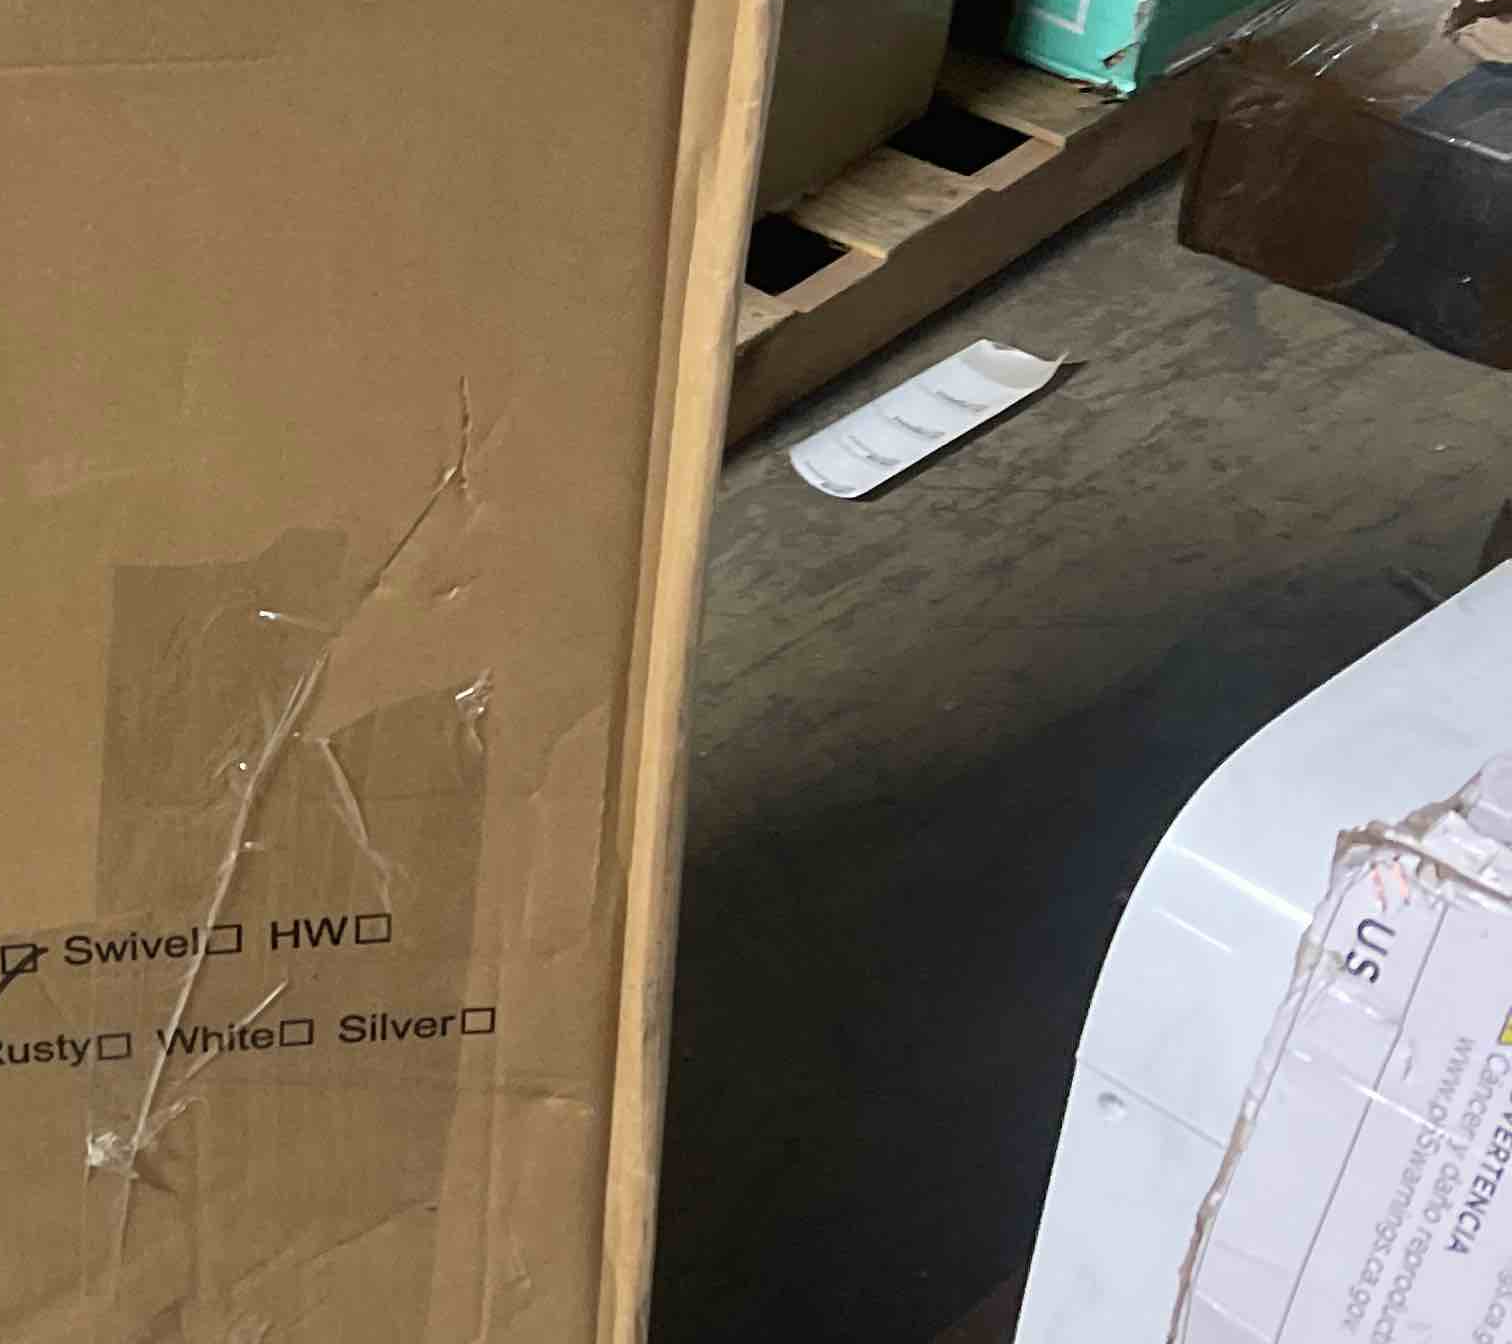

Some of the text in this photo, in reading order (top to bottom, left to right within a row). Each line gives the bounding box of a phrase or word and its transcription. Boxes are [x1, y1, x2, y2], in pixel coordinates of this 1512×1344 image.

[63, 926, 201, 967] Swivel
[270, 916, 349, 951] HW
[1345, 916, 1396, 983] US
[158, 1023, 276, 1057] White
[338, 1013, 457, 1044] Silver
